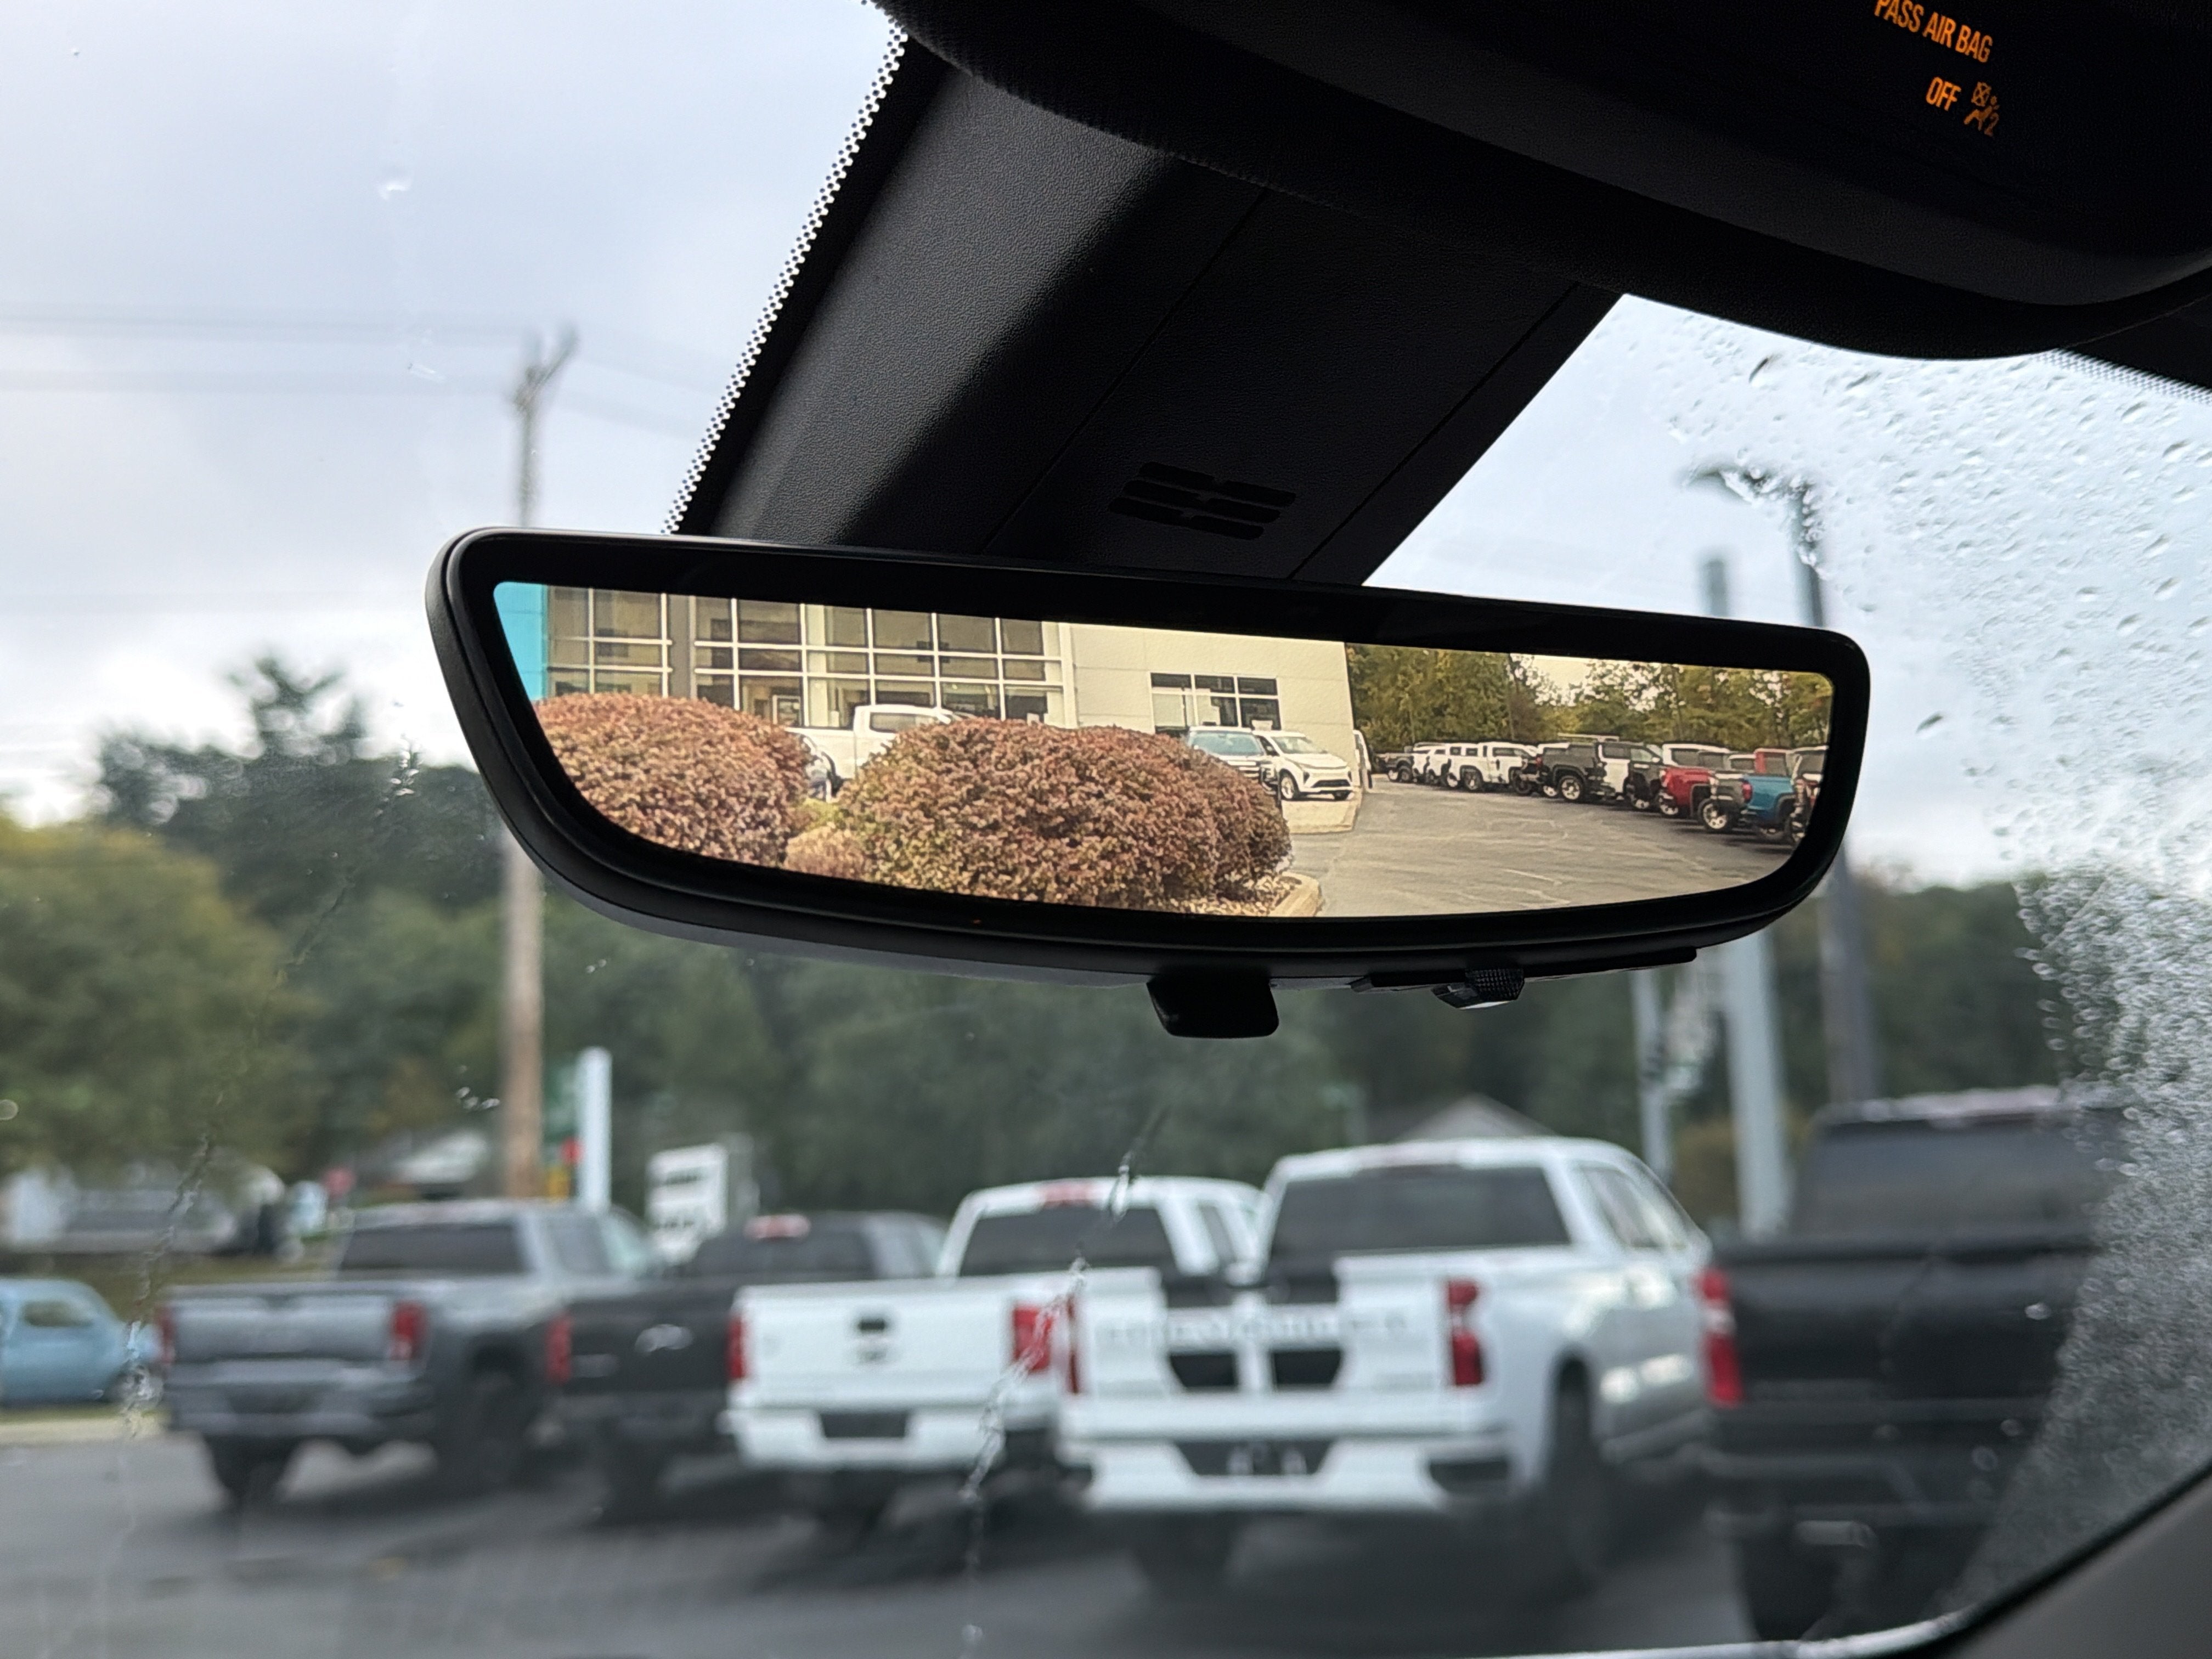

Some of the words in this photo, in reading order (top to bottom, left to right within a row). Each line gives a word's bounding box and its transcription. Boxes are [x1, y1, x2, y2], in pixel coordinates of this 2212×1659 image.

[1874, 0, 1924, 32] PASS
[1922, 12, 1957, 48] AIR
[1955, 25, 1993, 63] BAG
[1926, 77, 1962, 111] OFF
